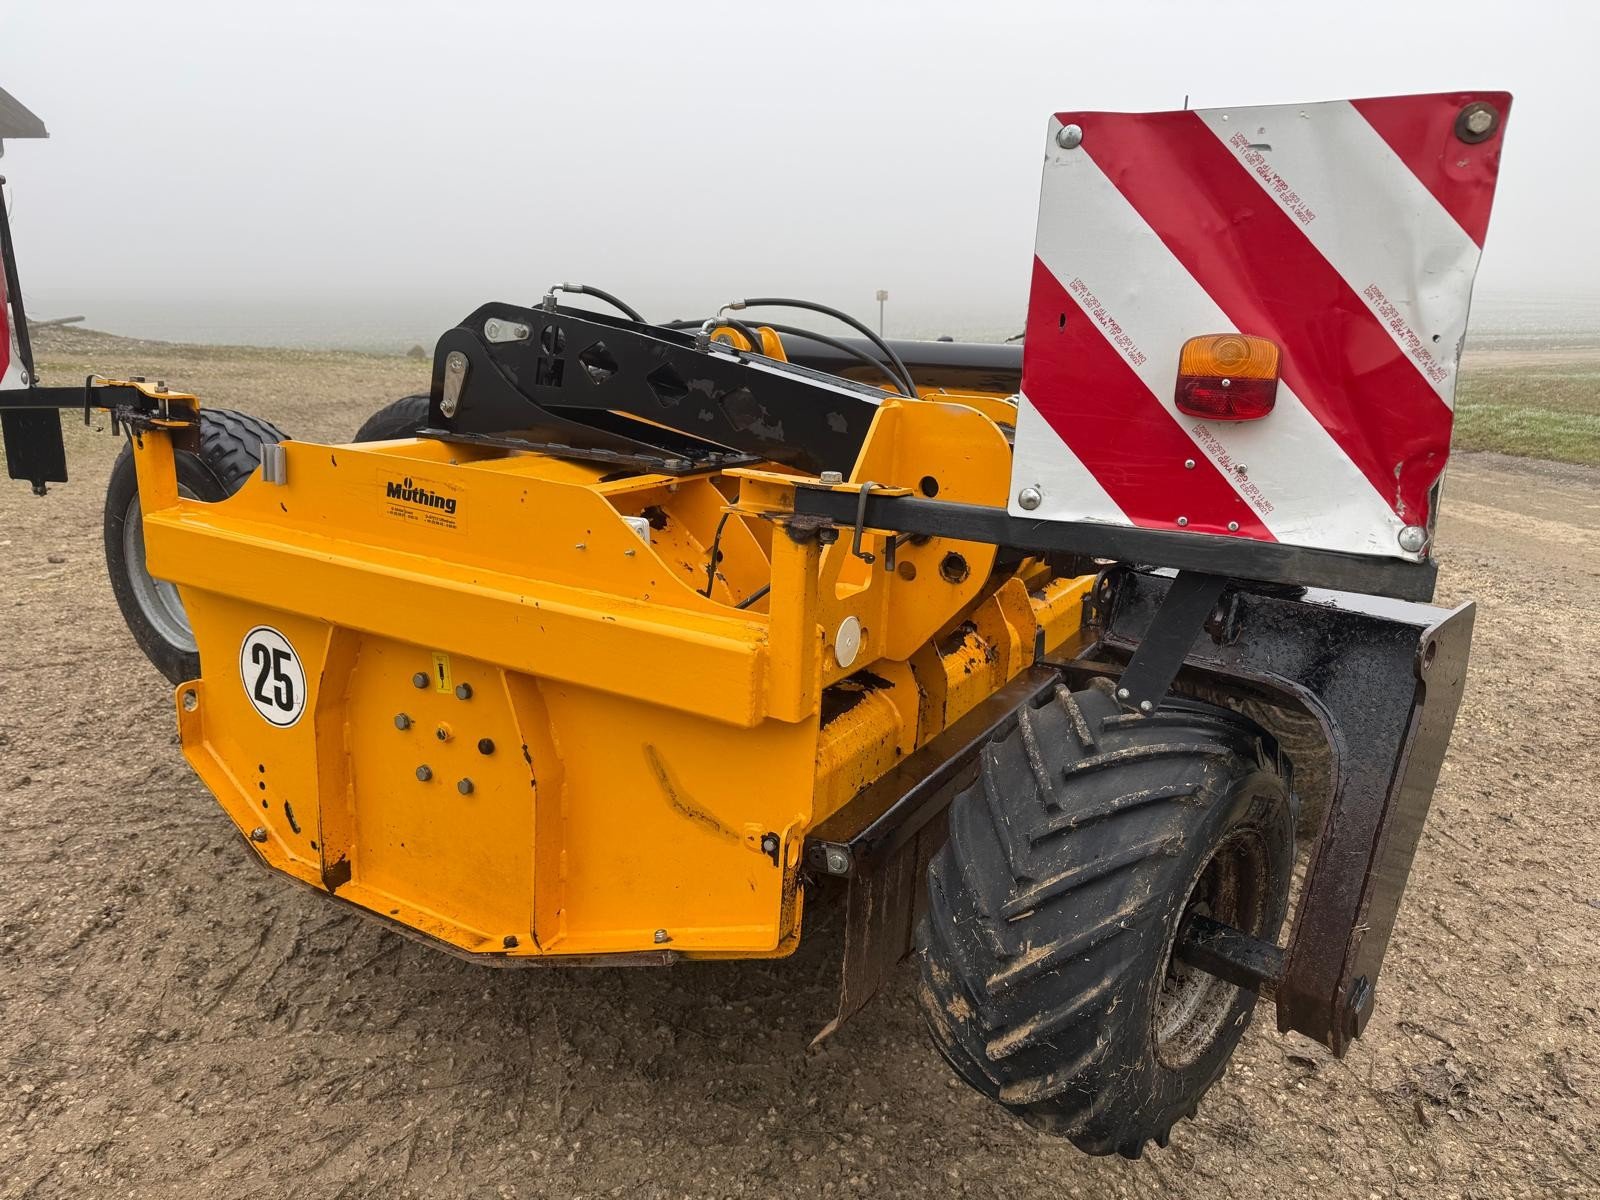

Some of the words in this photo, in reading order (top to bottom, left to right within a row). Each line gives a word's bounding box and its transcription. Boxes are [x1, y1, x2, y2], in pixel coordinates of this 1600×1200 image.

[1229, 136, 1240, 149] DIN
[1256, 165, 1271, 183] GEKA
[1273, 173, 1288, 191] GEKA
[1305, 208, 1315, 220] DIN
[1069, 281, 1079, 293] DIN
[1093, 309, 1107, 326] GEKA
[1363, 288, 1375, 300] DIN
[1390, 320, 1405, 338] GEKA
[1107, 317, 1122, 334] GEKA
[1405, 328, 1421, 346] GEKA
[1136, 351, 1146, 362] DIN
[1436, 366, 1447, 379] DIN
[1192, 427, 1202, 438] DIN
[1217, 456, 1233, 473] GEKA
[386, 477, 457, 514] Müthing
[1264, 500, 1273, 511] DIN
[252, 643, 294, 712] 25
